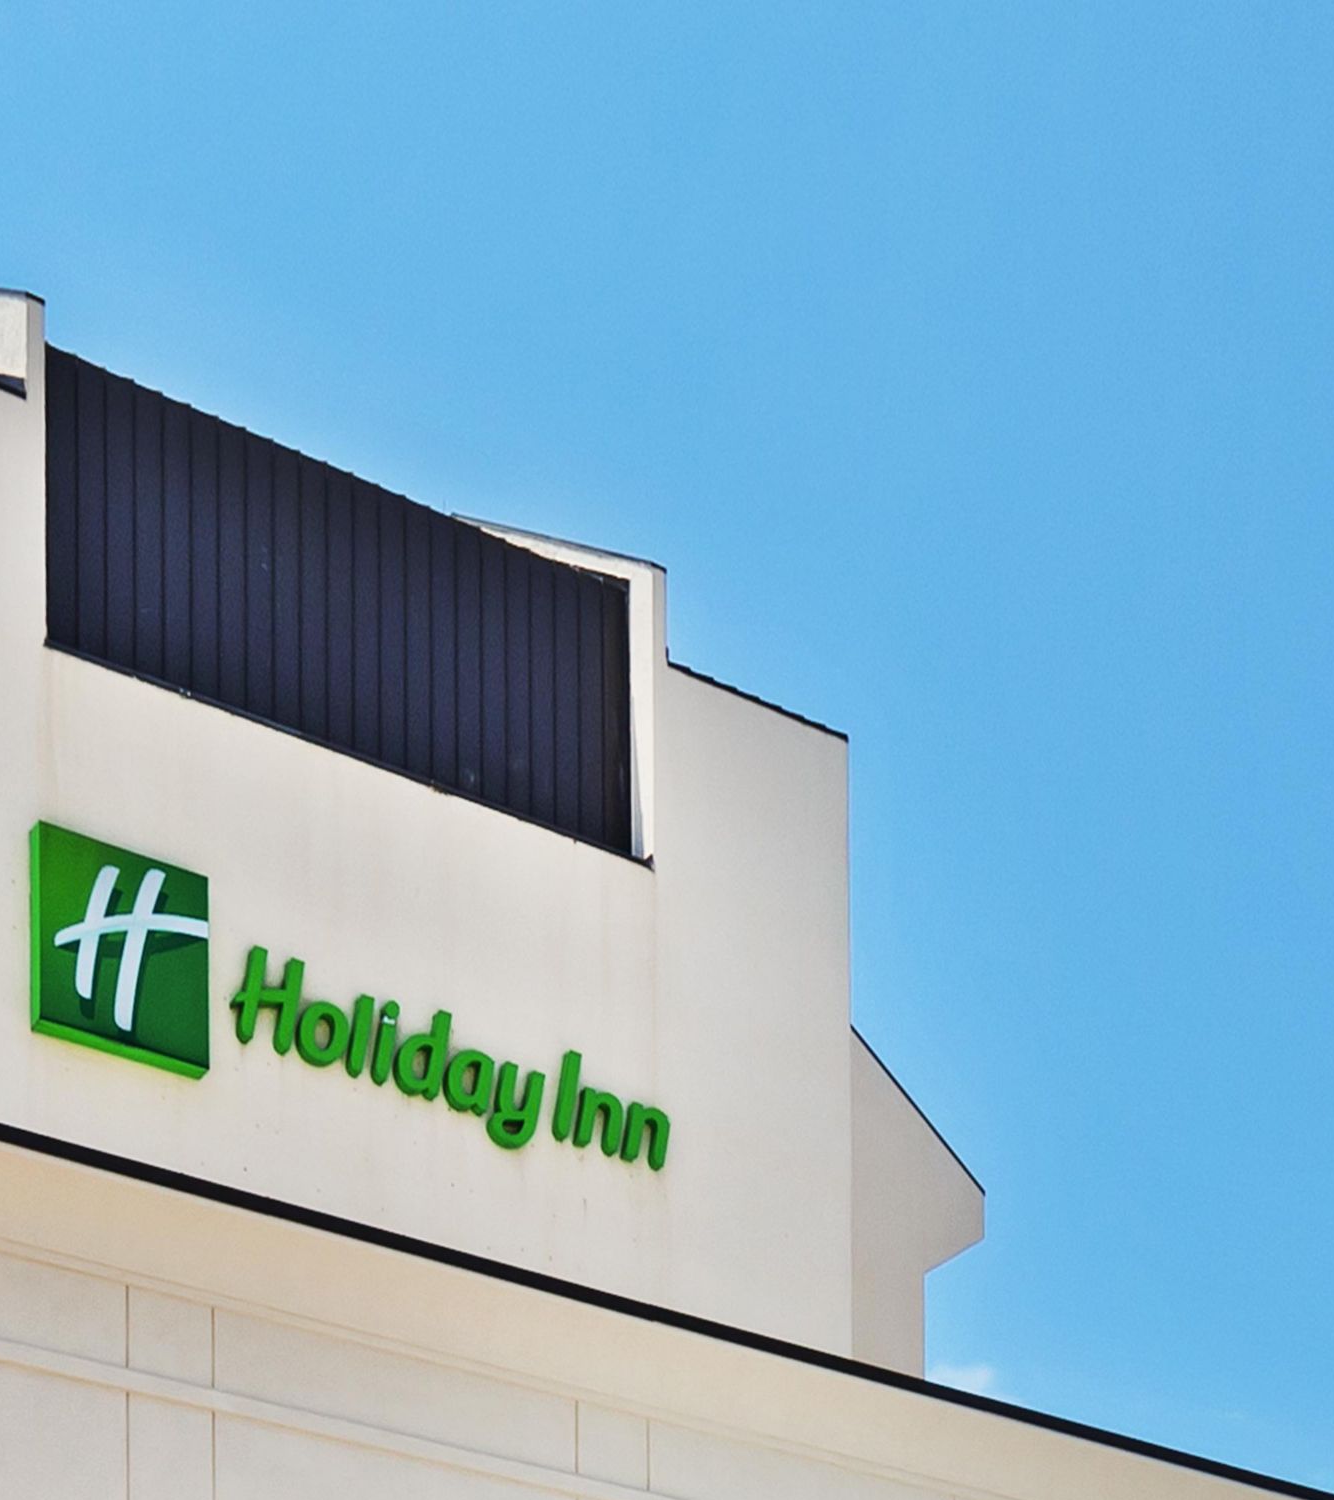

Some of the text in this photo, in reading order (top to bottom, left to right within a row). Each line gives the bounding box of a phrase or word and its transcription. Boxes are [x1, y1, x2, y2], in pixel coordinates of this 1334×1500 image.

[54, 865, 208, 1031] H
[229, 945, 671, 1171] Holiday Inn
